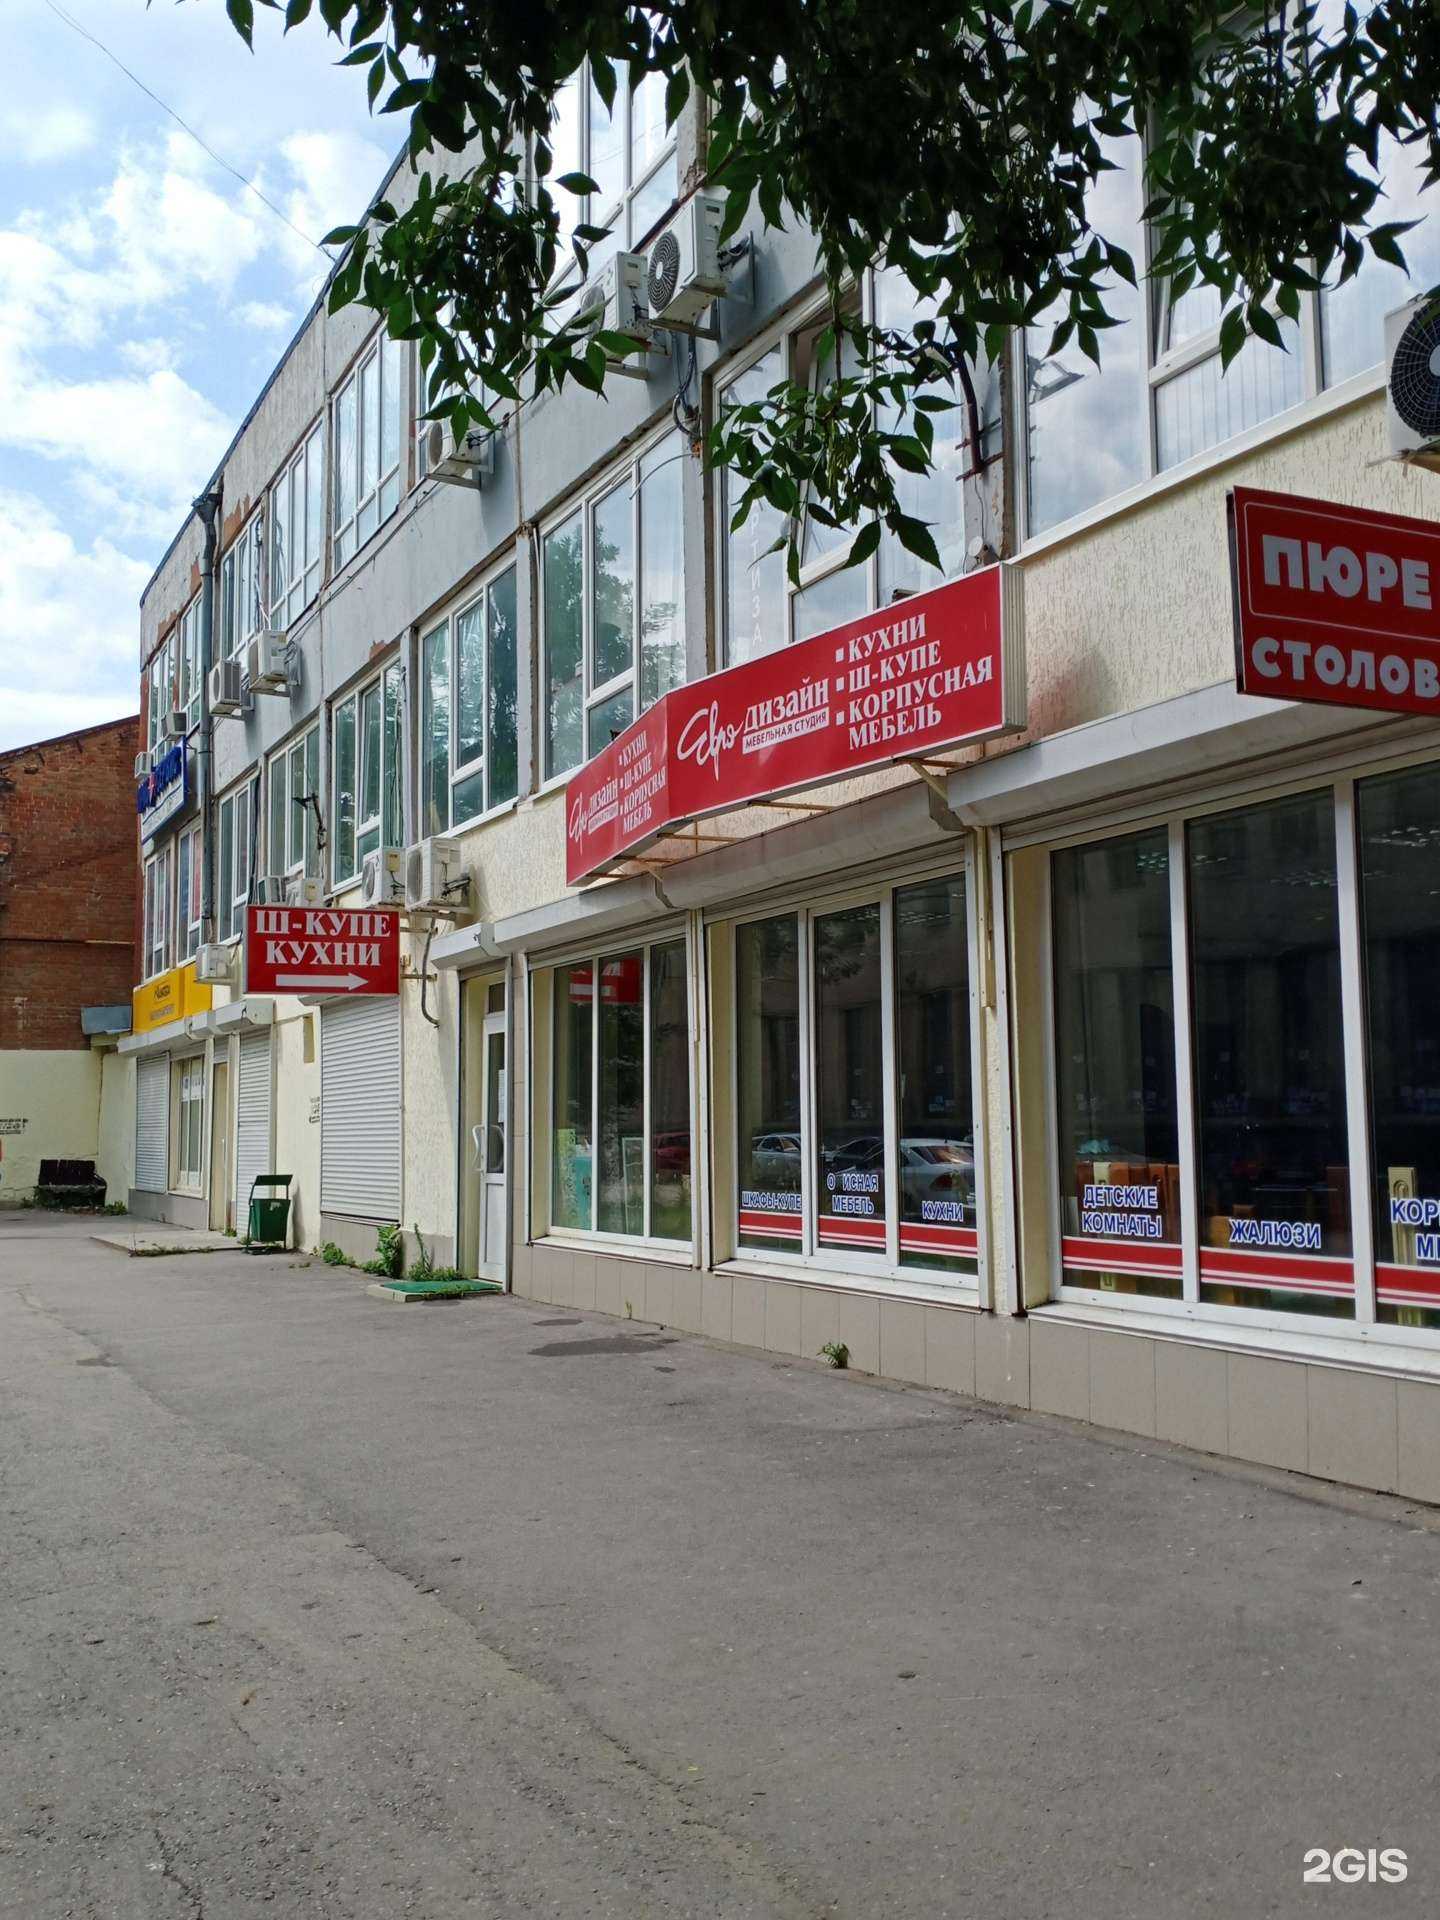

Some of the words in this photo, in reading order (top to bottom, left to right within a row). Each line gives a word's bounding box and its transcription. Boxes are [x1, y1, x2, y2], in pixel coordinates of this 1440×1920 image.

[1262, 534, 1432, 610] ПЮРЕ
[848, 612, 927, 664] КУХНИ
[848, 639, 942, 694] Ш-КУПЕ
[1251, 636, 1440, 698] СТОЛОВ
[848, 654, 994, 725] КОРПУСНАЯ
[744, 726, 794, 749] МЕБЕЛЬНАЯ
[794, 710, 828, 733] СТУДИЯ
[848, 702, 942, 751] МЕБЕЛЬ
[255, 910, 391, 938] Ш-КУПЕ
[265, 940, 381, 966] КУХНИ
[741, 1190, 802, 1210] ШКАФЫ-КУПЕ
[832, 1194, 875, 1214] МЕБЕЛЬ
[921, 1200, 964, 1222] КУХНИ
[1083, 1184, 1159, 1209] ДЕТСКИЕ
[1390, 1197, 1440, 1226] КОР
[1082, 1211, 1162, 1238] КОМНАТЫ
[1229, 1218, 1322, 1249] ЖАЛЮЗИ
